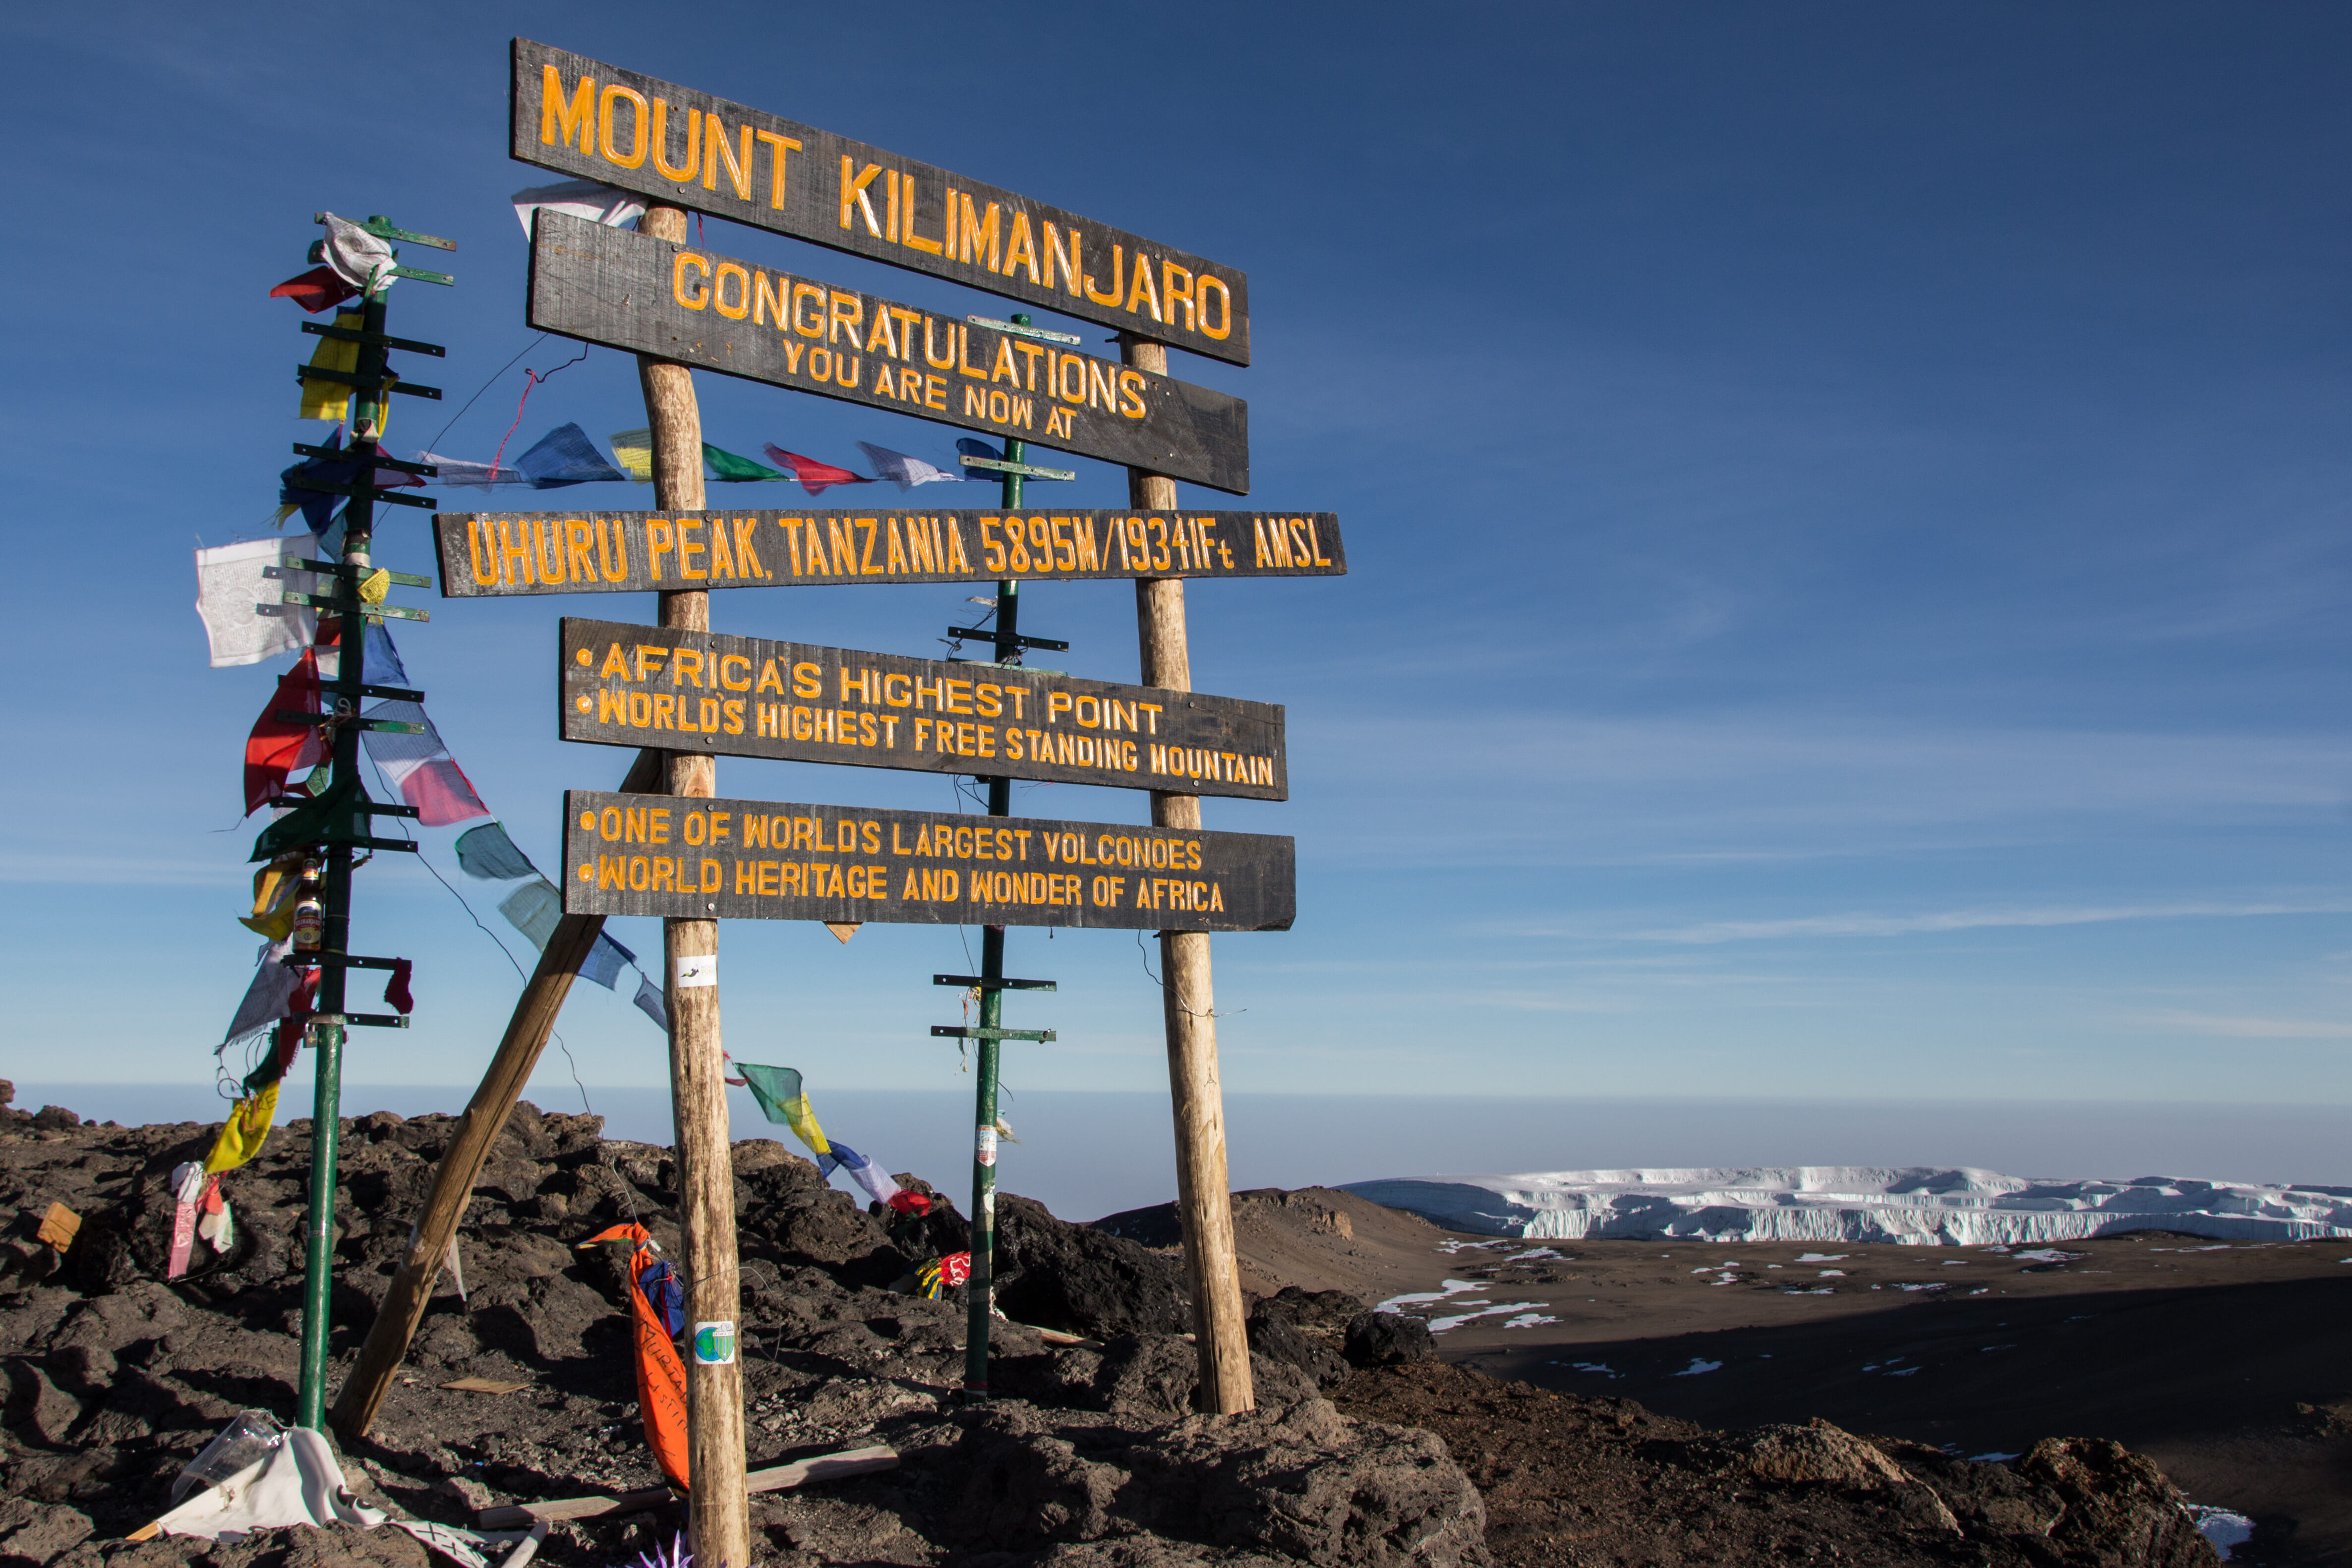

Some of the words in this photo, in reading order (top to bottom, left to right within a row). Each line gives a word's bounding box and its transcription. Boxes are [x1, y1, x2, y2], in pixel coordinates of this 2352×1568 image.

[541, 64, 802, 210] MOUNT
[840, 155, 1231, 341] KILIMANJARO
[674, 252, 1145, 418] CONGRATULATIONS
[783, 339, 859, 388] YOU
[875, 364, 946, 410] ARE
[965, 385, 1032, 429] NOW
[1046, 406, 1077, 440] AT
[467, 520, 628, 585] UHURU
[1254, 518, 1331, 568] AMSL
[600, 642, 821, 698] AFRICA'S
[841, 667, 1030, 719] HIGHEST
[1048, 692, 1163, 735] POINT
[599, 688, 744, 735] WORLD'S
[758, 703, 898, 748] HIGHEST
[915, 717, 995, 757] FREE
[1006, 728, 1137, 771] STANDING
[1150, 744, 1272, 786] MOUNTAIN
[598, 854, 722, 893] WORLD
[735, 860, 887, 899] HERITAGE
[902, 868, 959, 902] AND
[971, 871, 1082, 905] WONDER
[1093, 876, 1125, 907] OF
[1137, 878, 1224, 912] AFRICA
[600, 807, 670, 844] ONE
[684, 811, 730, 846] OF
[744, 813, 881, 854] WORLD'S
[893, 823, 1031, 861] LARGEST
[1043, 832, 1202, 871] VOLCONOES
